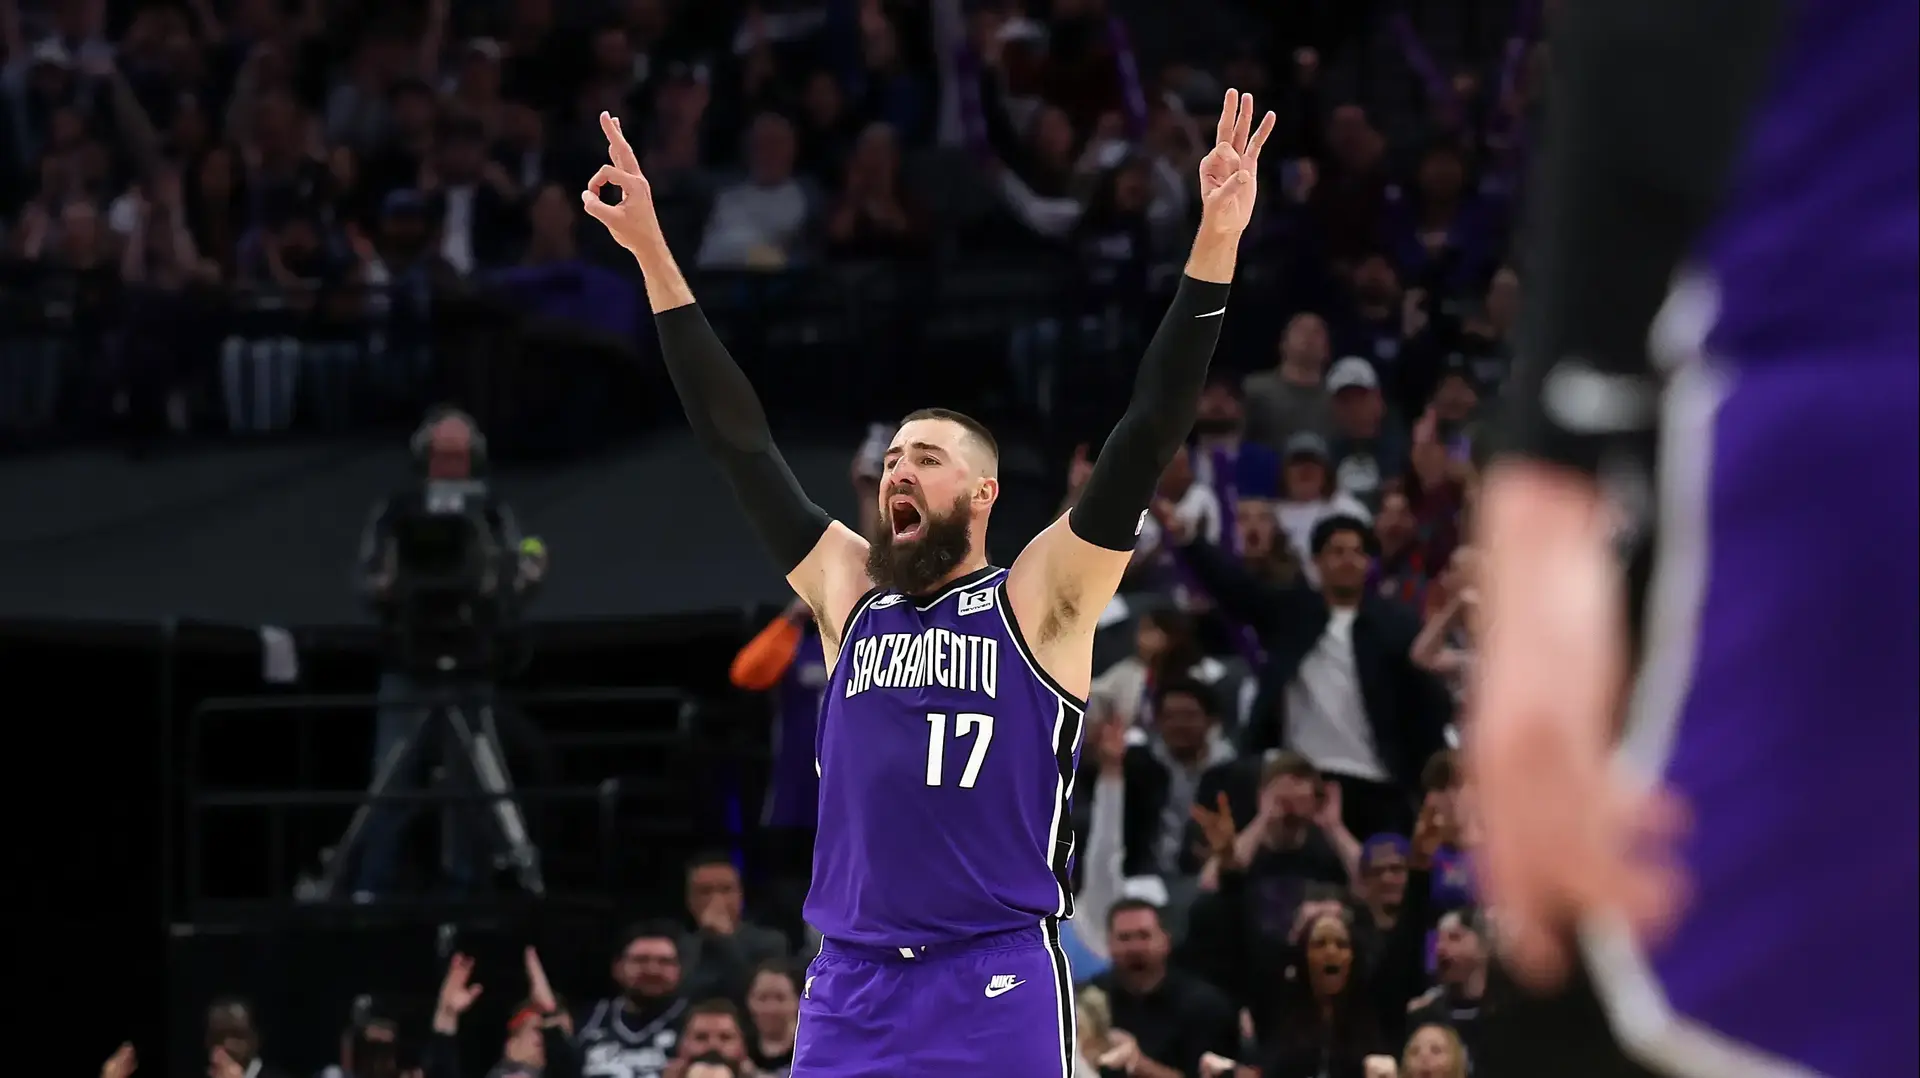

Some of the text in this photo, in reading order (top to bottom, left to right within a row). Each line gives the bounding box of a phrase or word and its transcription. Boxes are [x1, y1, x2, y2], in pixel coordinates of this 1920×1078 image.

[967, 592, 987, 605] R
[846, 627, 998, 699] SACRAMENTO
[926, 713, 994, 788] 17
[990, 974, 1017, 989] NIKE
